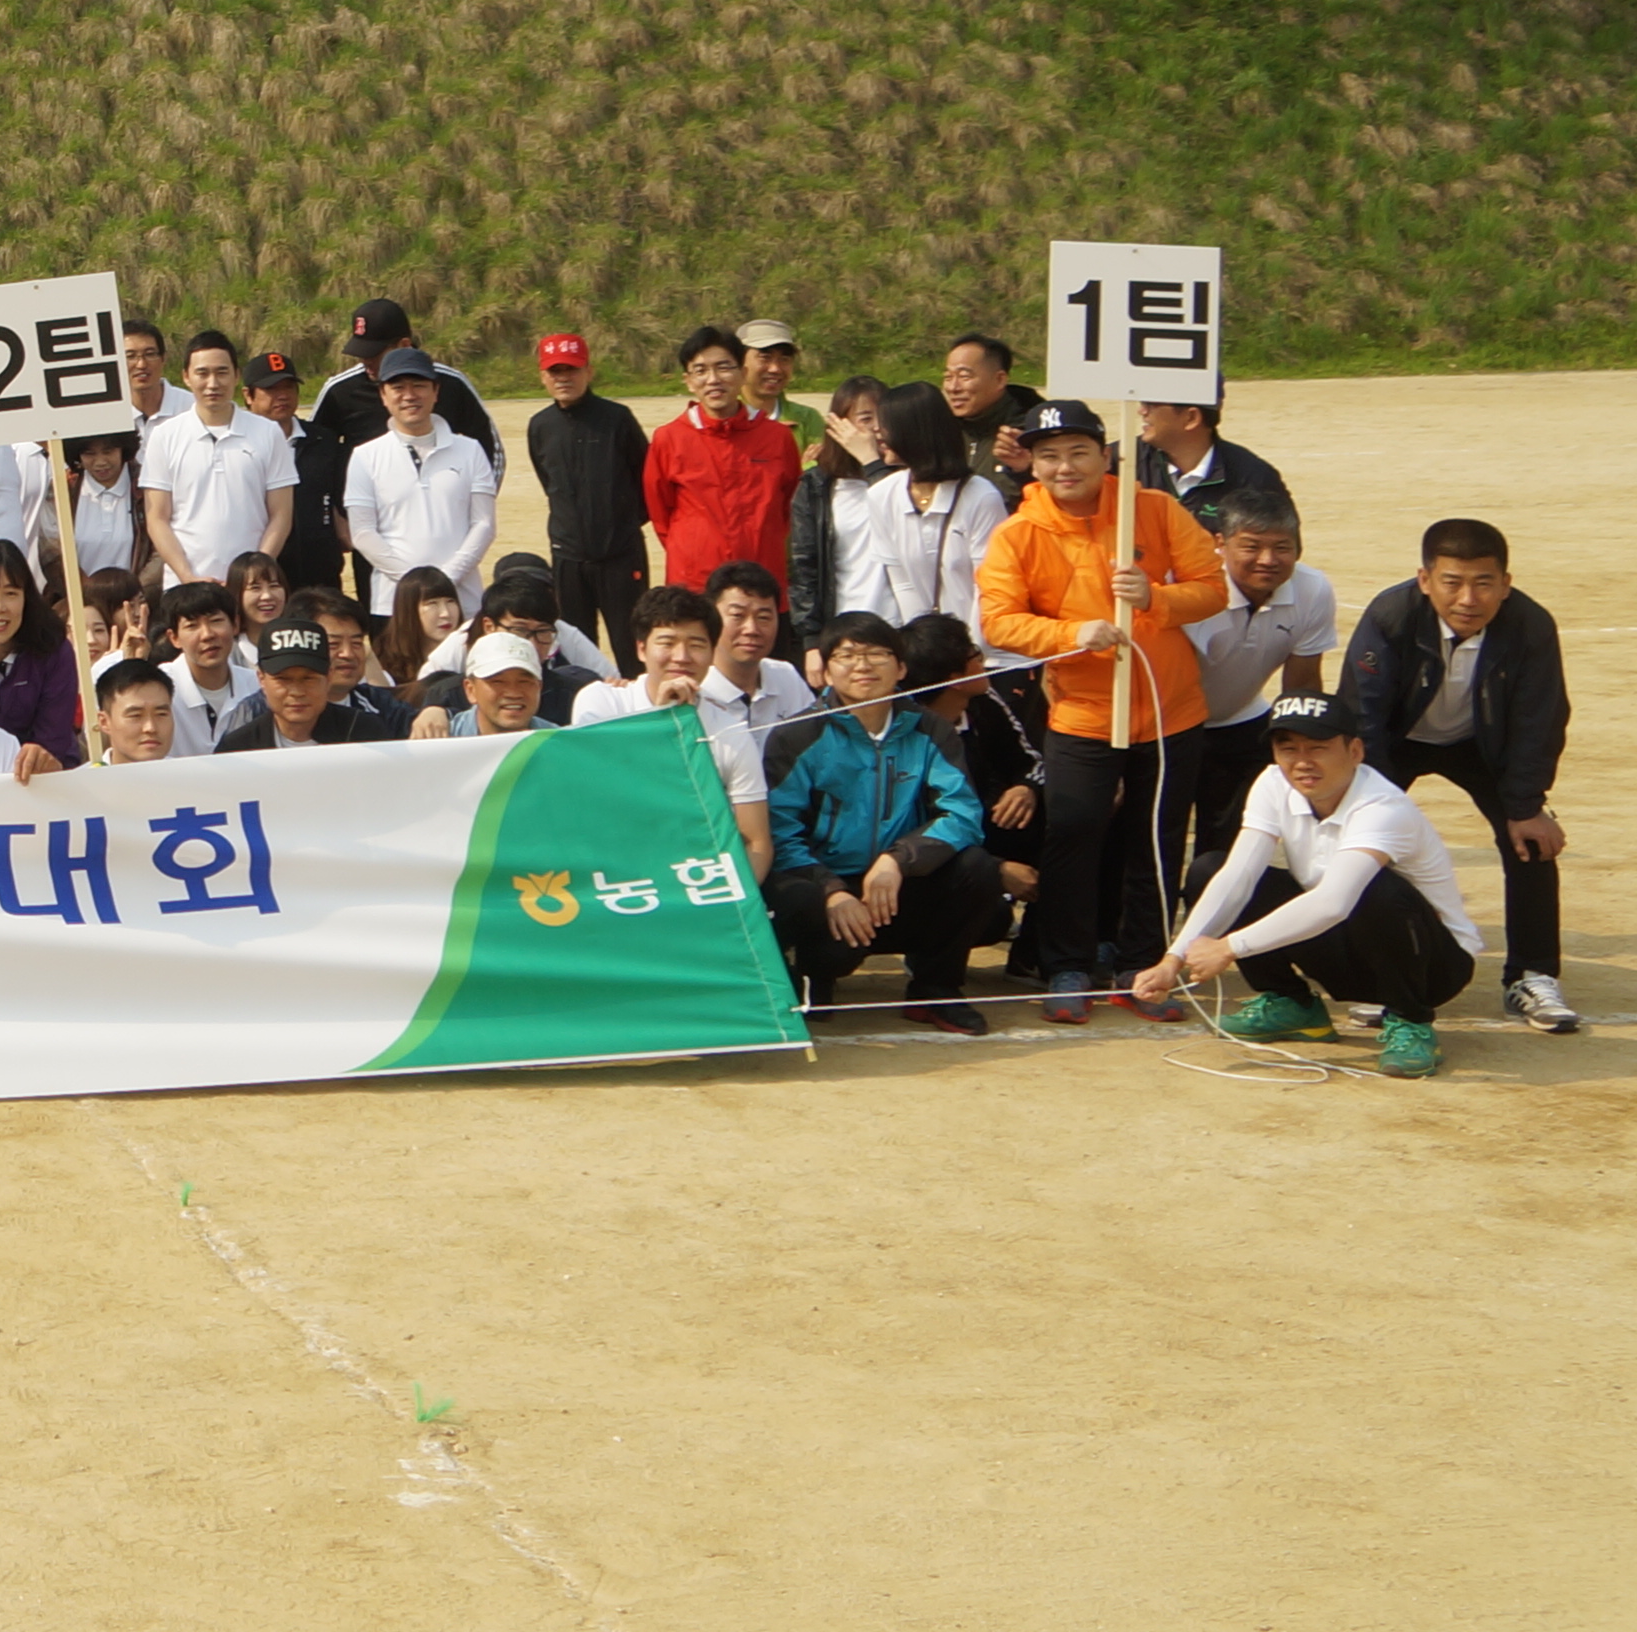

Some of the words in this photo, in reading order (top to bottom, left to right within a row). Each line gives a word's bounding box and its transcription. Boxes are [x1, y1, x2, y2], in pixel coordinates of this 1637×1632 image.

[1067, 279, 1210, 371] 1팀
[267, 353, 286, 372] B
[1038, 406, 1063, 429] NY
[270, 629, 321, 651] STAFF
[1271, 696, 1329, 720] STAFF
[591, 852, 747, 915] 농협
